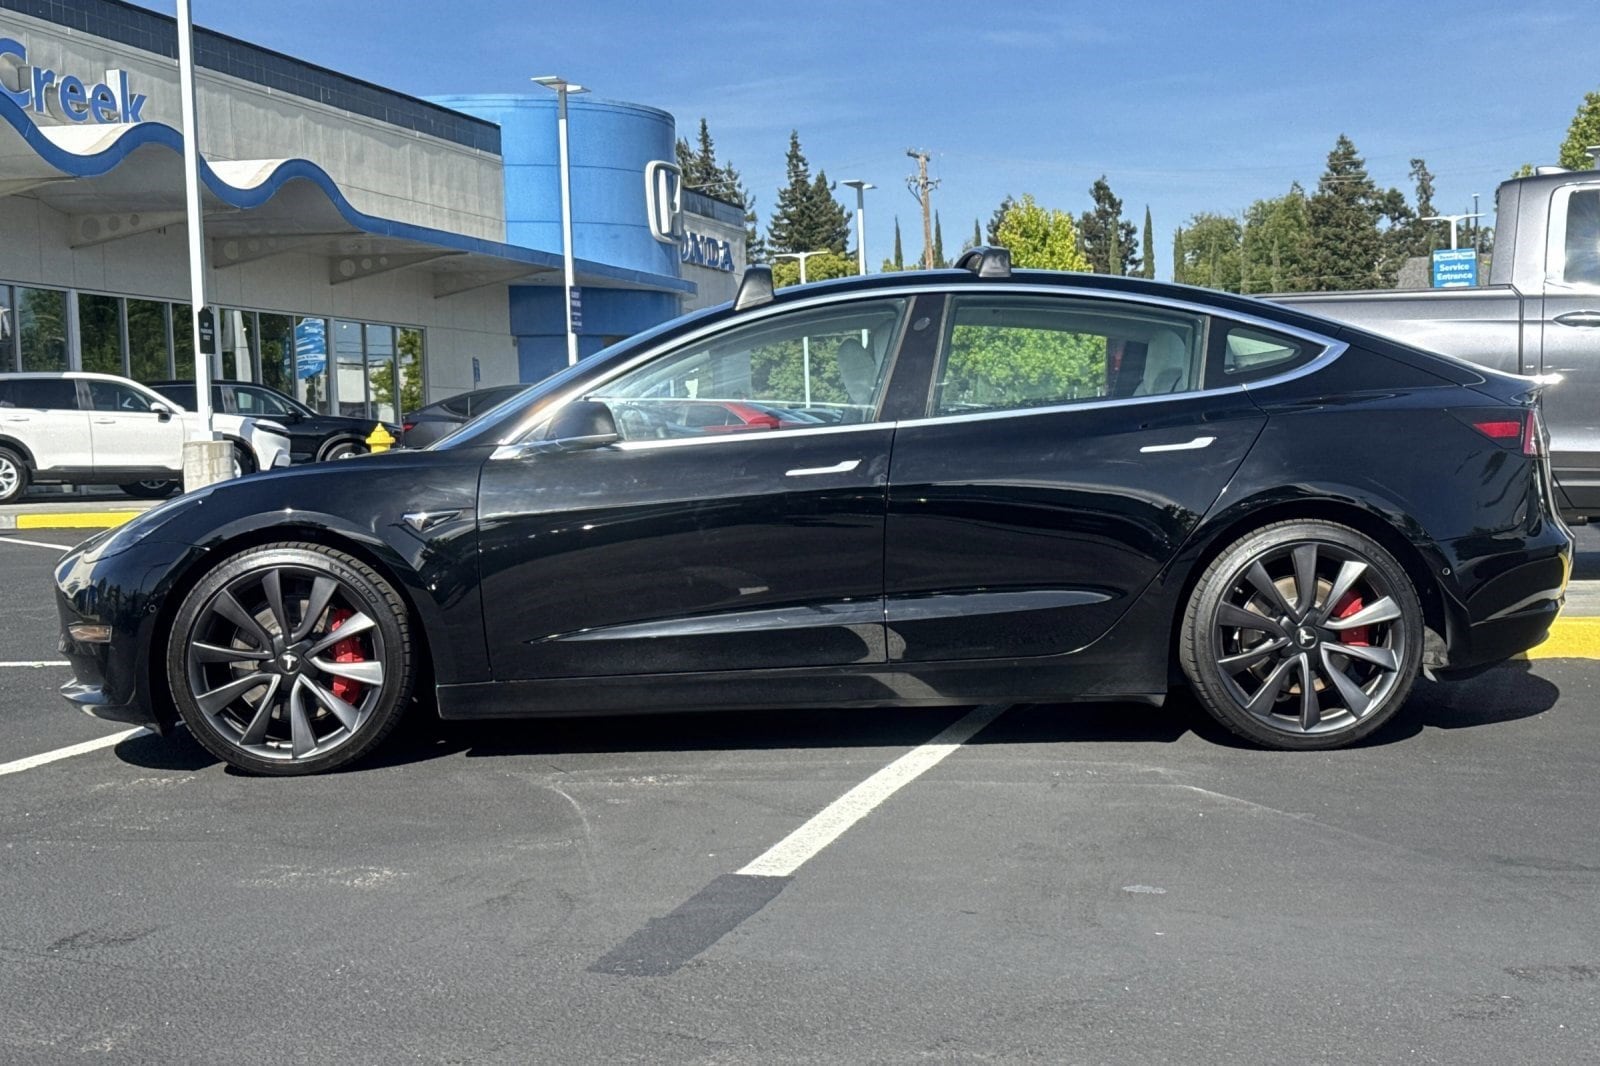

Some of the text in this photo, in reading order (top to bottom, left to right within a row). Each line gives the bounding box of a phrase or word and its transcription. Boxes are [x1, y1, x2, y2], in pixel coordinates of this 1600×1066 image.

[0, 37, 147, 124] Creek
[681, 229, 735, 272] ONDA
[1436, 272, 1473, 281] Entrance
[1439, 262, 1470, 271] Service
